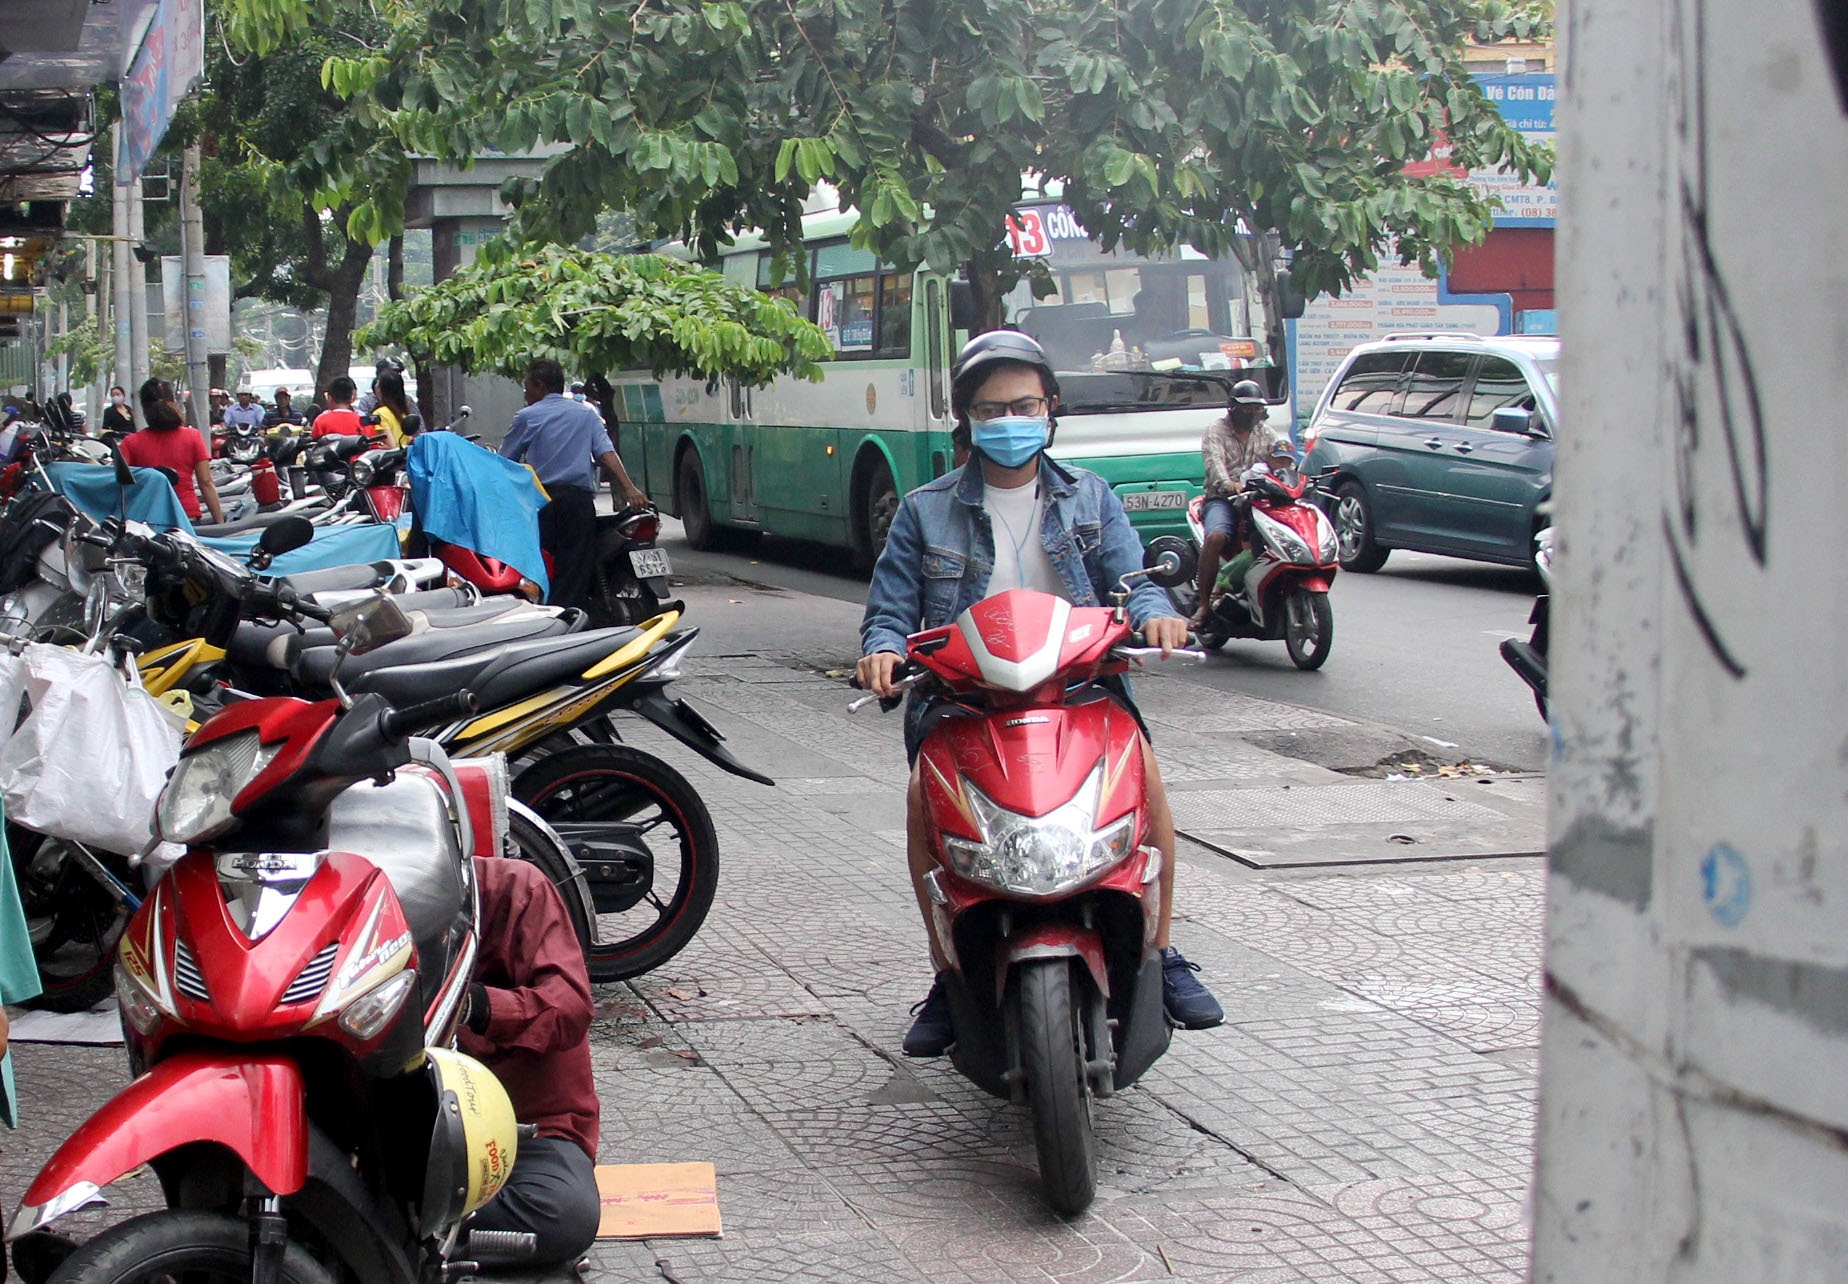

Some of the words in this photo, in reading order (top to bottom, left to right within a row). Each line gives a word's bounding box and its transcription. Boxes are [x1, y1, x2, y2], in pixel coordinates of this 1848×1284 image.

[231, 857, 297, 870] HONDA
[124, 950, 145, 976] 125
[485, 1140, 500, 1172] FOOD
